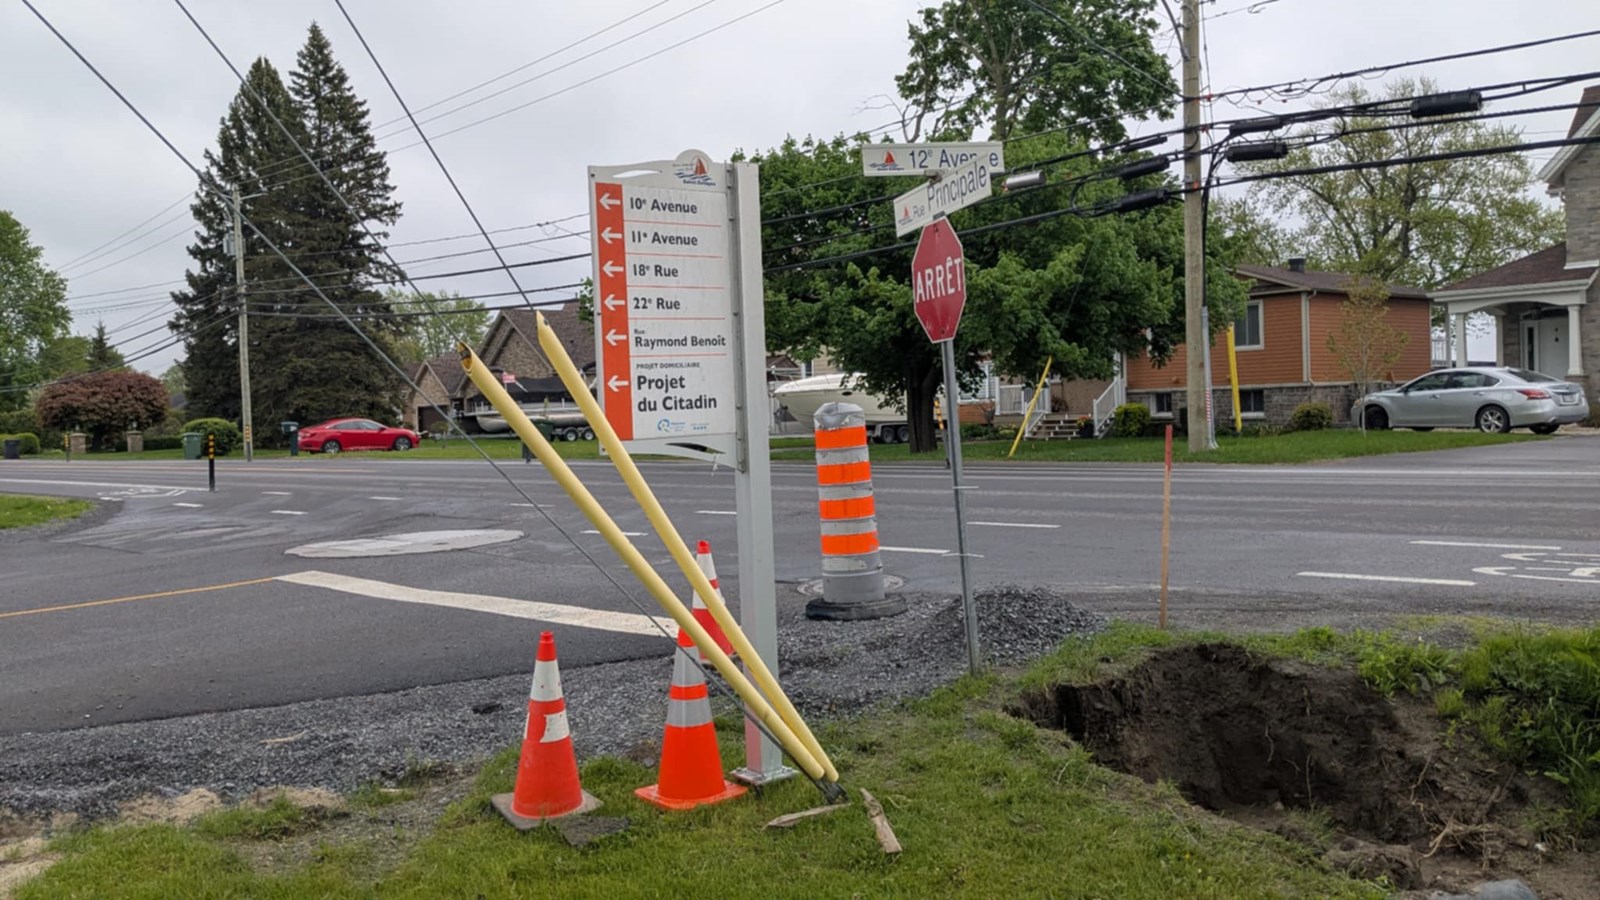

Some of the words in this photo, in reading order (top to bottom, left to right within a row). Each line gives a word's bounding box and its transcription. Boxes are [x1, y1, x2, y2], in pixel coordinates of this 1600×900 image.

[939, 148, 999, 169] Avee
[912, 204, 926, 219] Rue
[927, 161, 987, 212] Principale
[651, 199, 698, 214] Avenue
[651, 232, 698, 246] Avenue
[654, 264, 679, 278] Rue
[916, 257, 962, 303] ARRÊT
[656, 298, 681, 311] Rue
[635, 336, 688, 350] Raymond
[690, 334, 727, 347] Benoît
[636, 362, 659, 370] PROJET
[636, 374, 686, 394] Projet
[637, 397, 657, 412] du
[662, 394, 717, 411] Citadin
